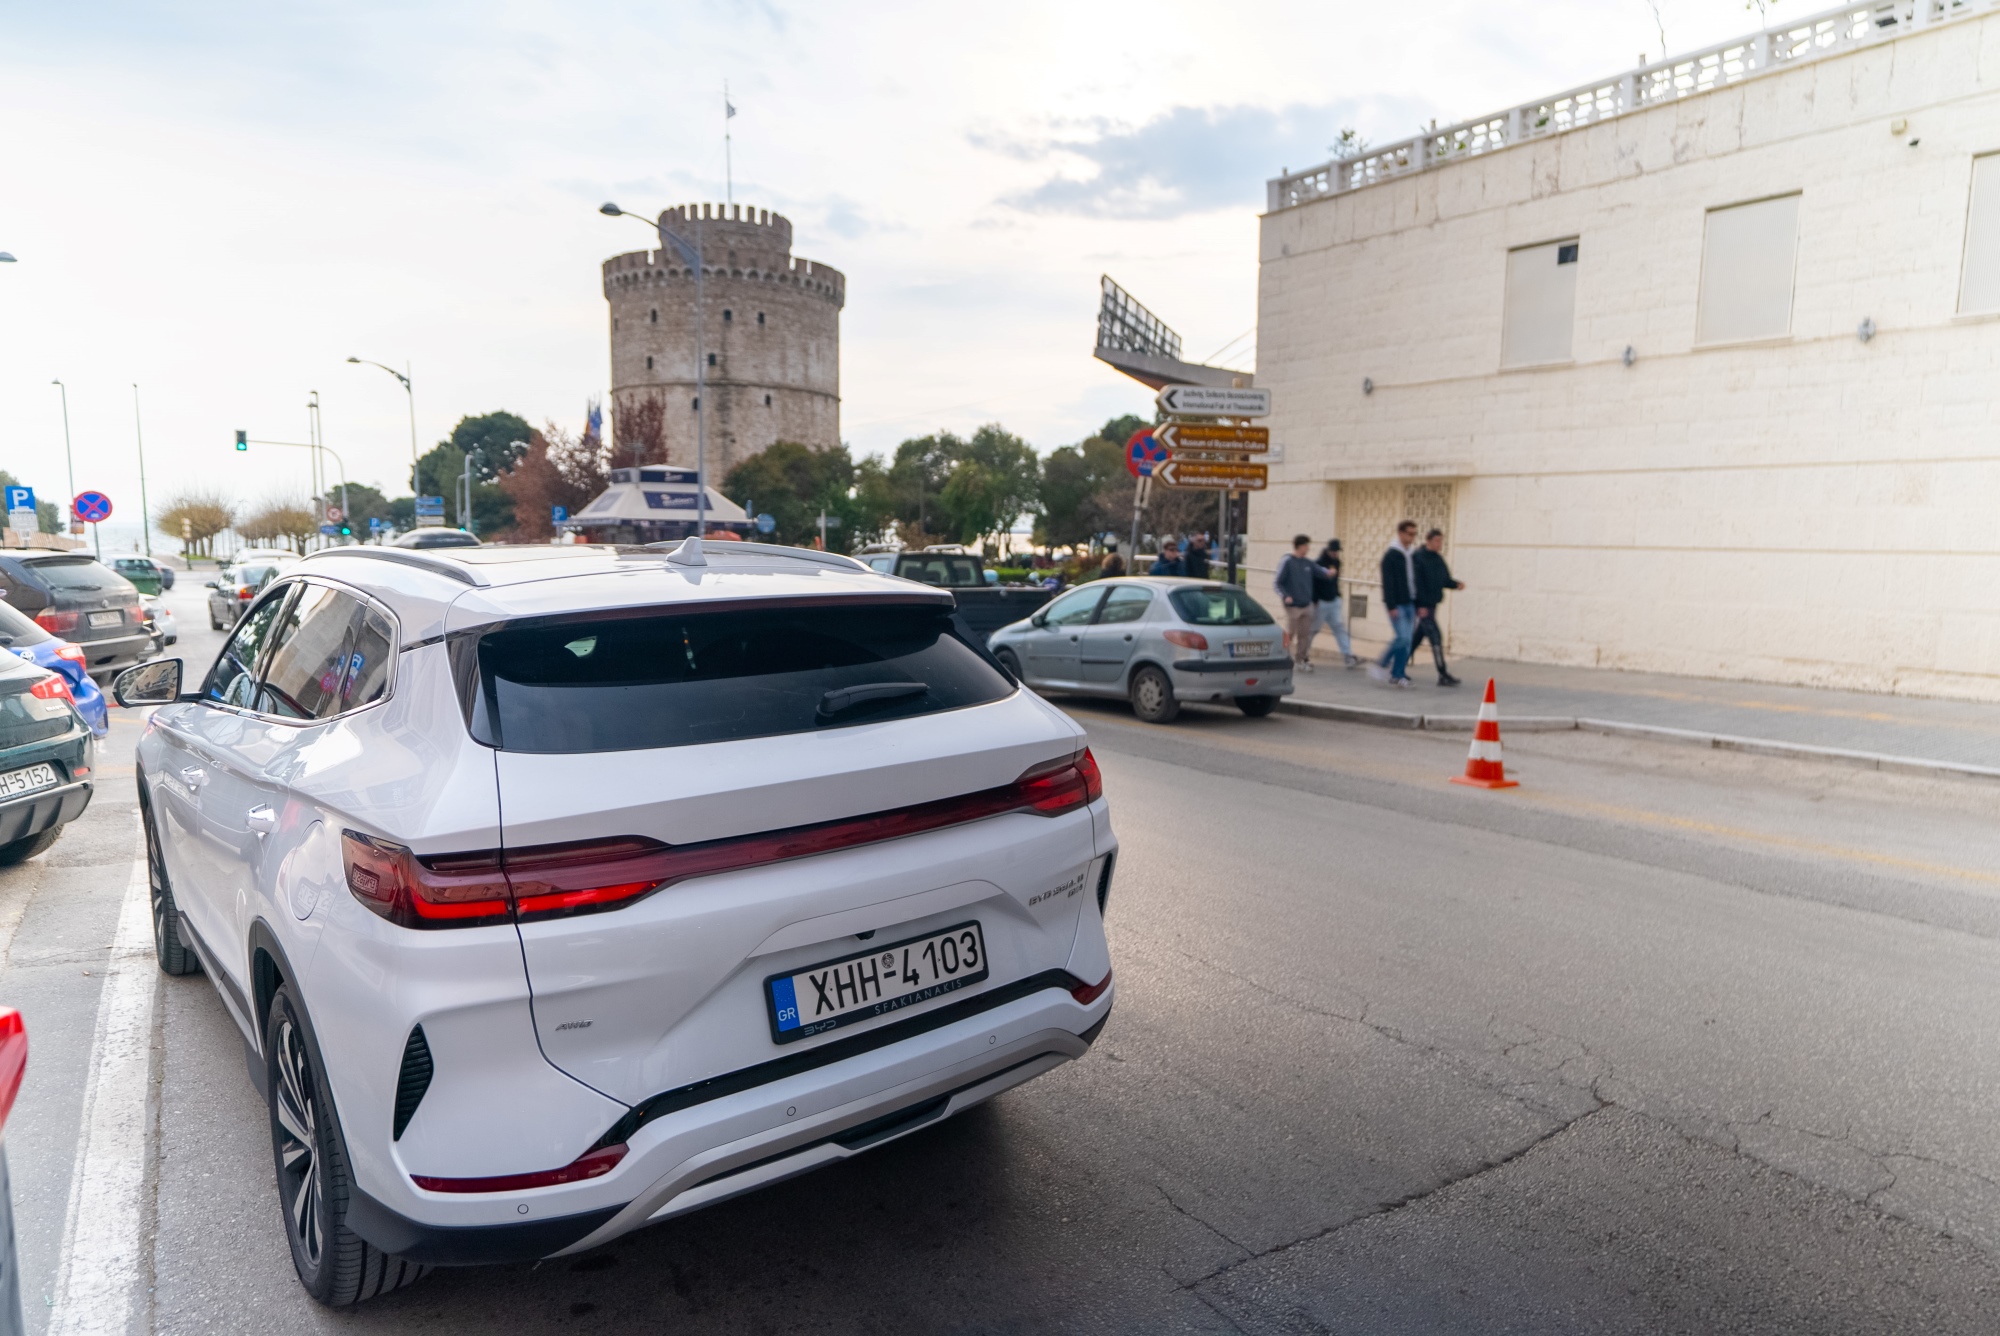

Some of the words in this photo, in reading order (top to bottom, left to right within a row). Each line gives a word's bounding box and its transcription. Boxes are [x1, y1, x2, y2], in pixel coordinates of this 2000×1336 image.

[1180, 438, 1206, 447] Museum
[1207, 439, 1213, 447] of
[1214, 439, 1243, 449] Byzantine
[1244, 441, 1266, 449] Culture
[12, 489, 28, 506] P
[0, 766, 54, 795] H-5152
[808, 931, 978, 1016] XHH-4103
[874, 980, 962, 1015] SFAKIANAKIS
[778, 1007, 796, 1022] GR
